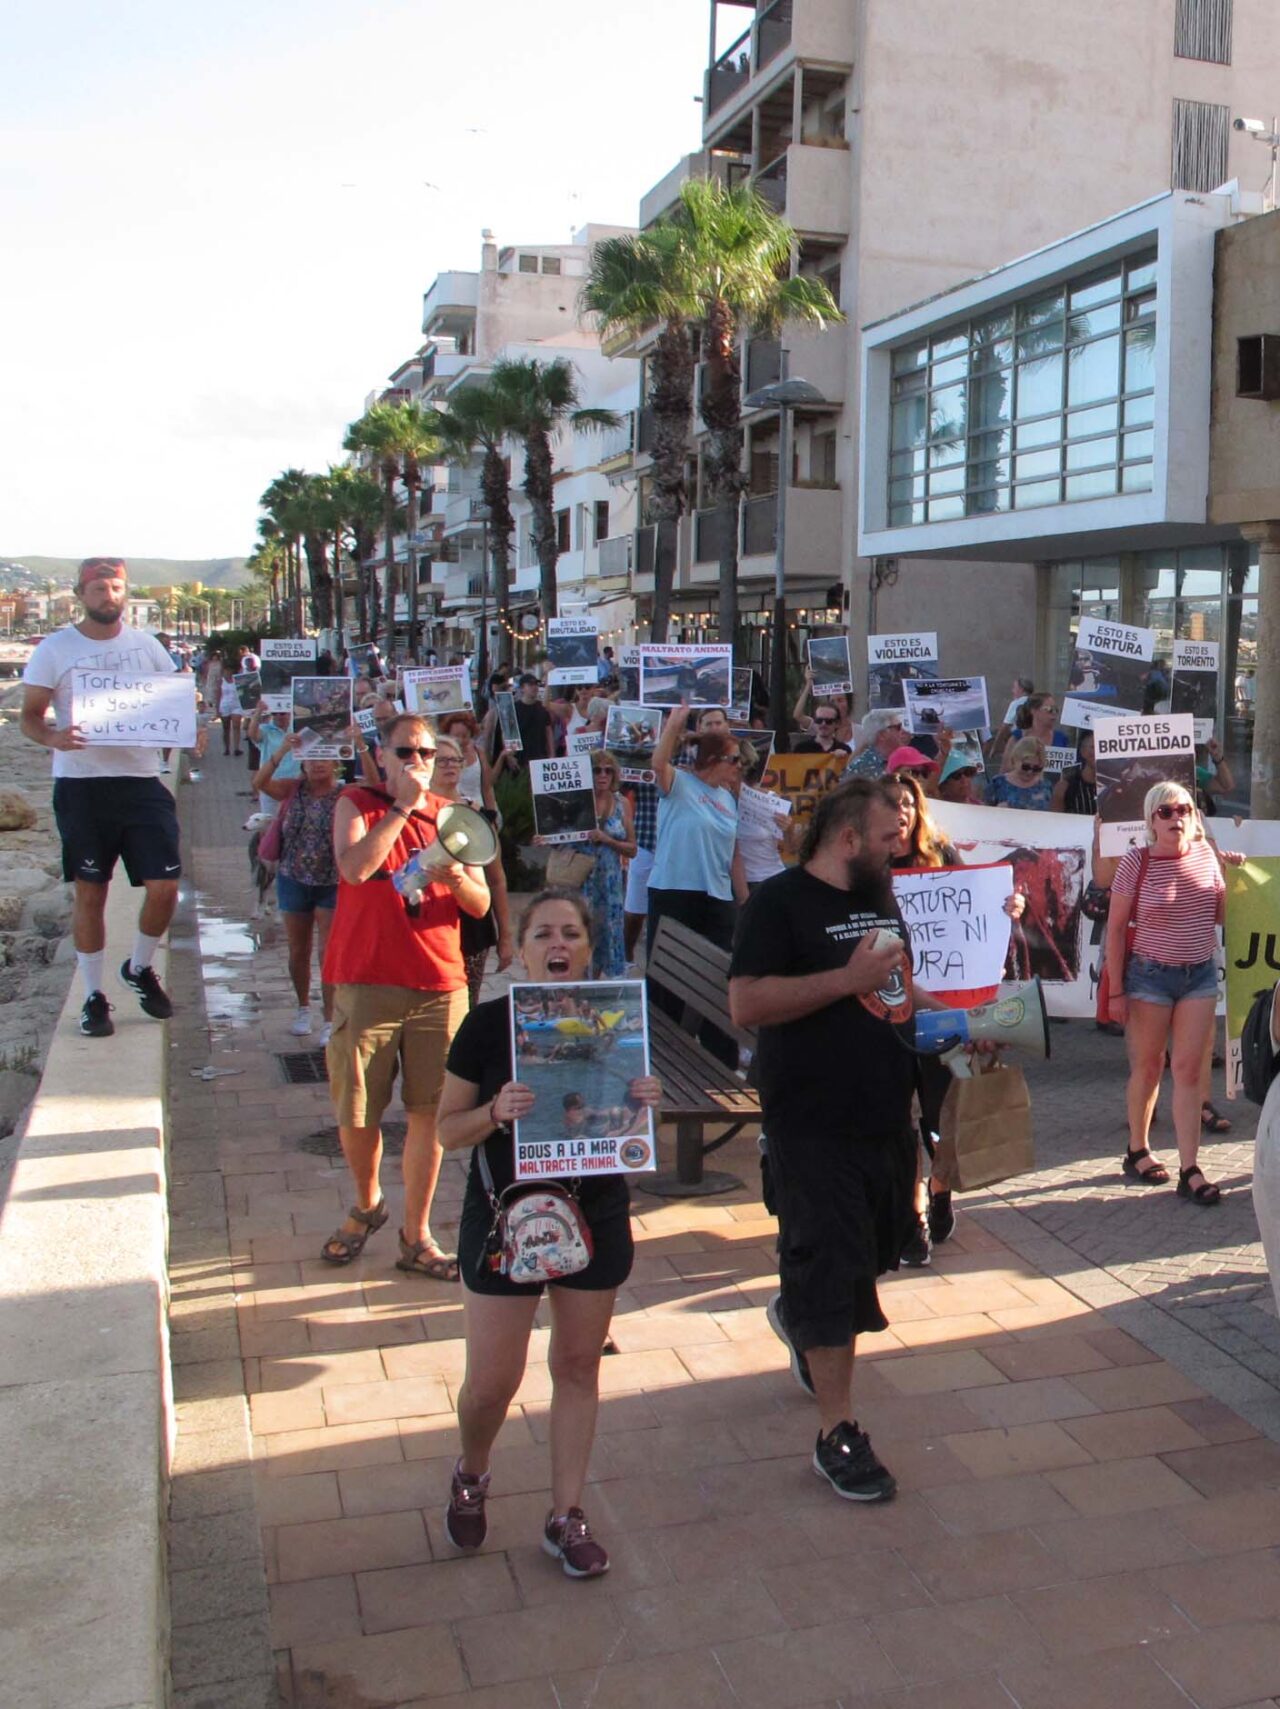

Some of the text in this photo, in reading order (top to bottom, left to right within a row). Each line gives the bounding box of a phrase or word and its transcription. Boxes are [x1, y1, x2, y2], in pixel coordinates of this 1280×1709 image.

[550, 626, 597, 635] BRUTALIDAD
[1097, 625, 1138, 642] ESTO ES
[884, 638, 922, 648] ESTO ES
[1087, 634, 1143, 656] TORTURA
[1184, 645, 1209, 655] ESTO ES
[266, 650, 312, 658] CRUELDAD
[875, 646, 932, 660] VIOLENCIA
[1177, 655, 1215, 667] TORMENTO
[78, 672, 155, 694] Torture
[1118, 722, 1171, 736] ESTO ES
[1098, 735, 1191, 754] BRUTALIDAD
[543, 760, 579, 772] NO ALS
[543, 770, 581, 782] BOUS A
[544, 779, 582, 792] LA MAR
[961, 914, 988, 943] NI
[518, 1139, 617, 1160] BOUS A LA MAR
[519, 1155, 619, 1175] MALTRACTE ANIMAL
